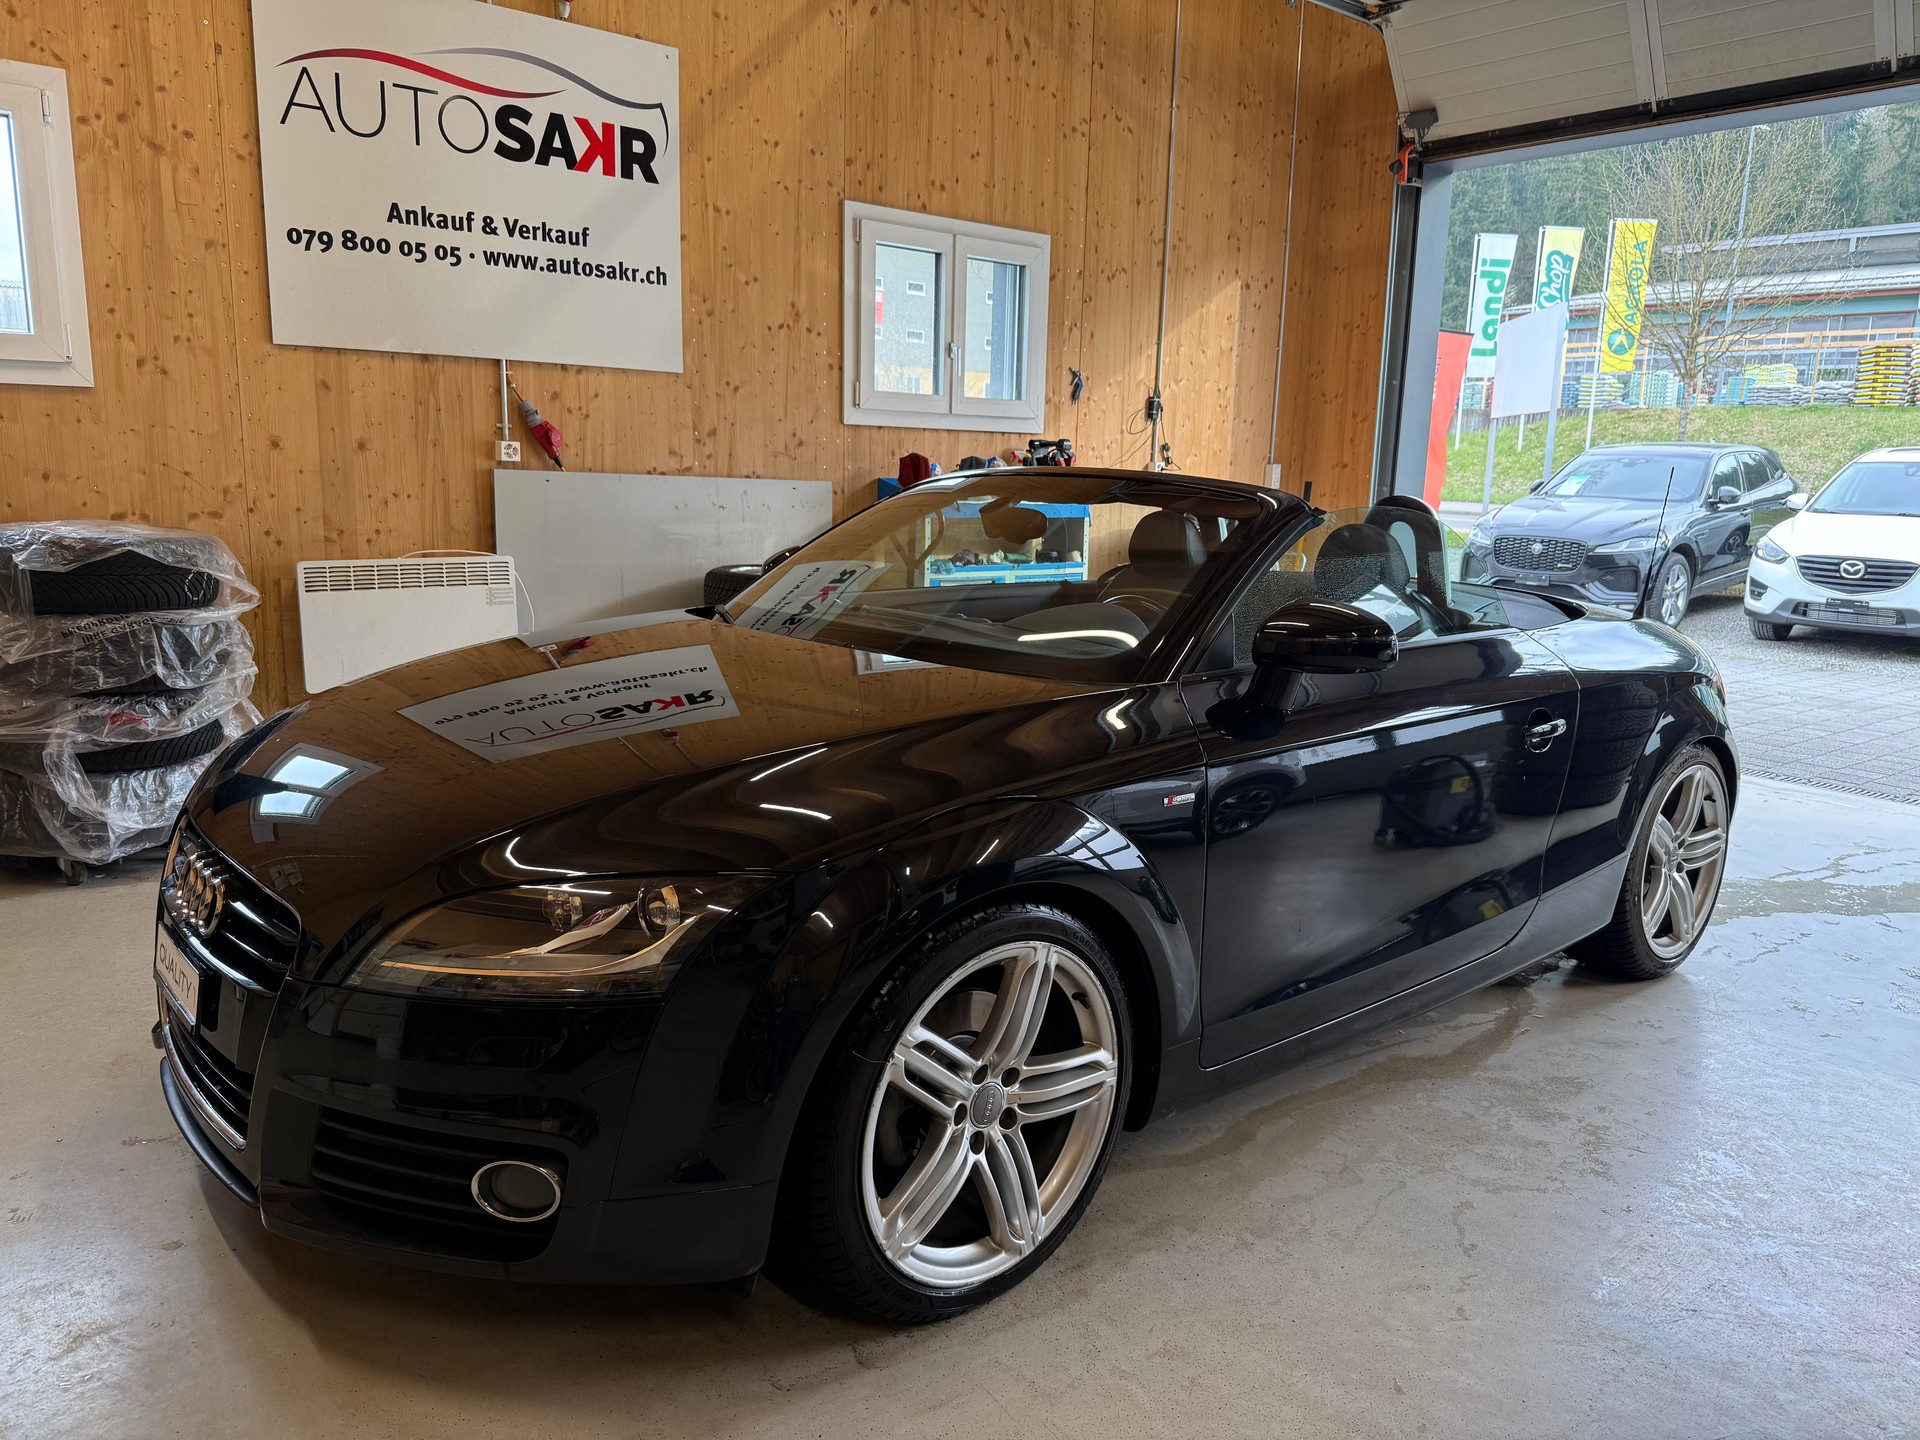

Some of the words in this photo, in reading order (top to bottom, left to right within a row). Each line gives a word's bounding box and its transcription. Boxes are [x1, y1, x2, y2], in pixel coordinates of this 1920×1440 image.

[386, 201, 476, 234] Ankauf
[481, 214, 499, 237] &
[502, 216, 590, 248] Verkauf
[286, 226, 334, 253] 079
[341, 229, 392, 255] 800
[399, 240, 428, 264] 05
[434, 244, 462, 267] 05
[483, 249, 668, 287] www.autosakr.ch
[1471, 257, 1511, 357] Landi
